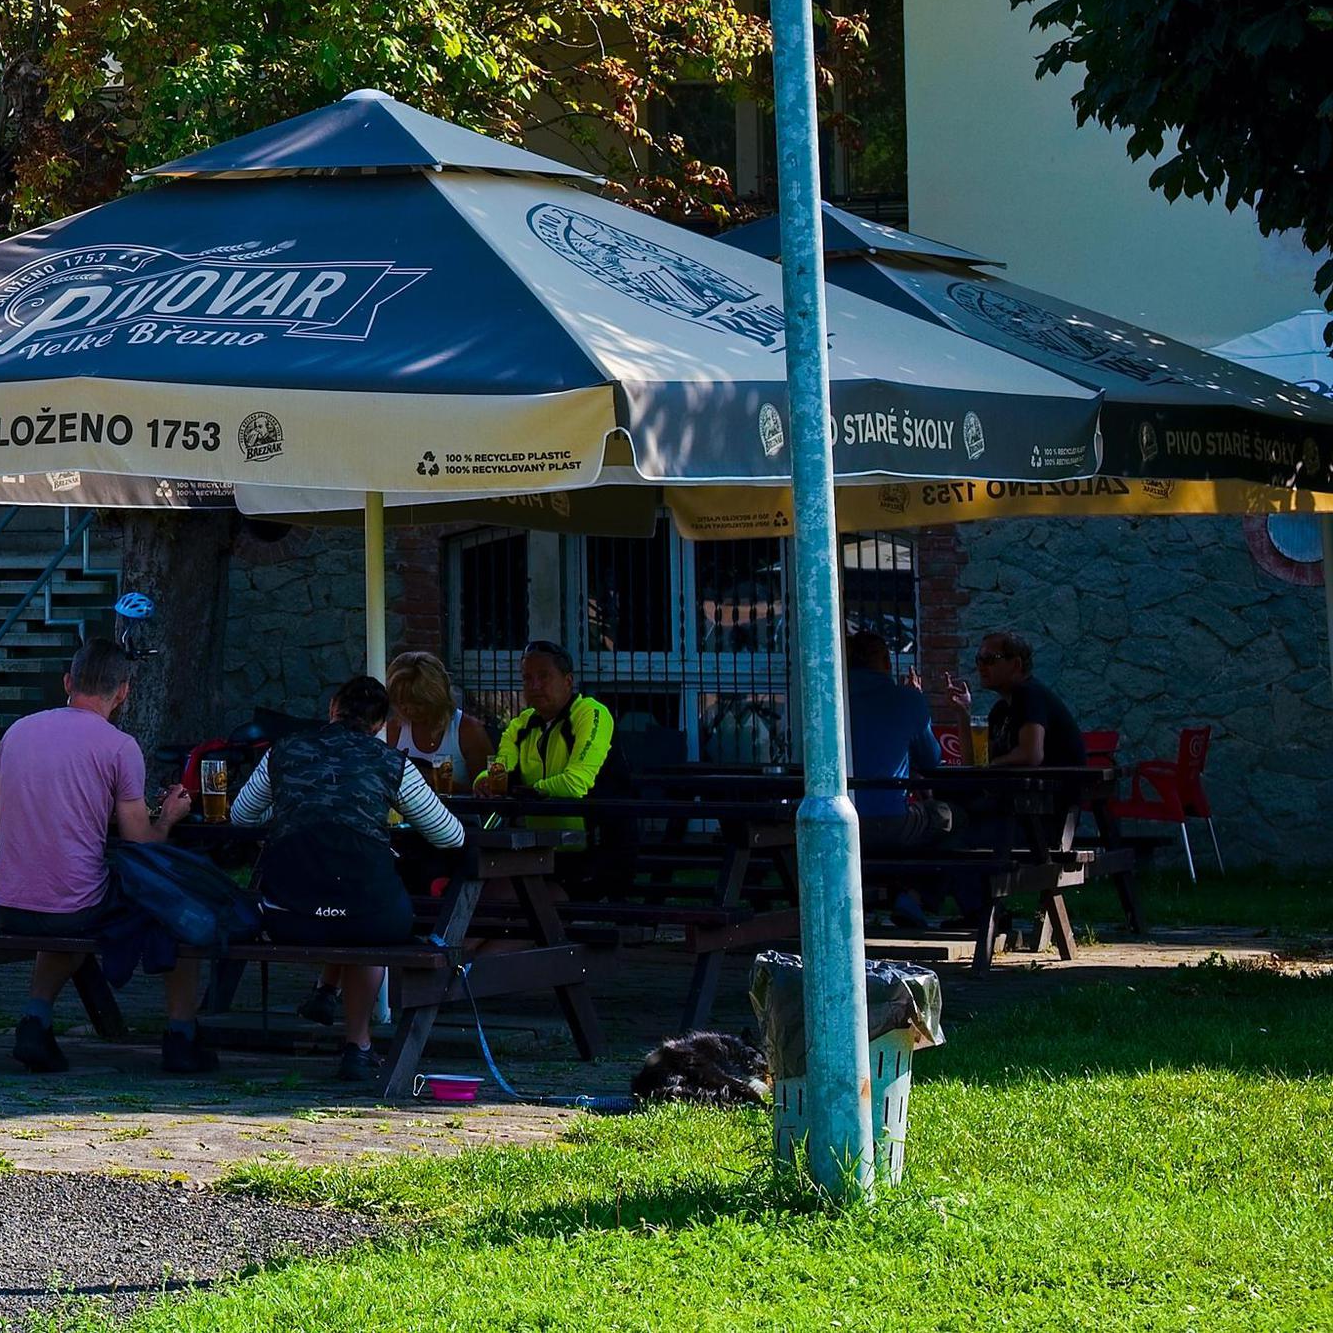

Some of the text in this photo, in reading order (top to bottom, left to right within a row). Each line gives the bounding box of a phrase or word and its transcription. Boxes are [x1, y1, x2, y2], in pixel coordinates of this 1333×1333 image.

[64, 252, 107, 268] 1753
[19, 321, 269, 360] Velké Březno
[147, 419, 221, 452] 1753
[843, 407, 899, 445] STARÉ
[902, 410, 955, 450] ŠKOLY
[445, 450, 571, 463] 100 % RECYCLED PLASTIC
[1166, 431, 1202, 455] PIVO
[1206, 429, 1252, 459] STARÉ
[445, 461, 582, 475] 100% RECYKLOVANÝ PLAST
